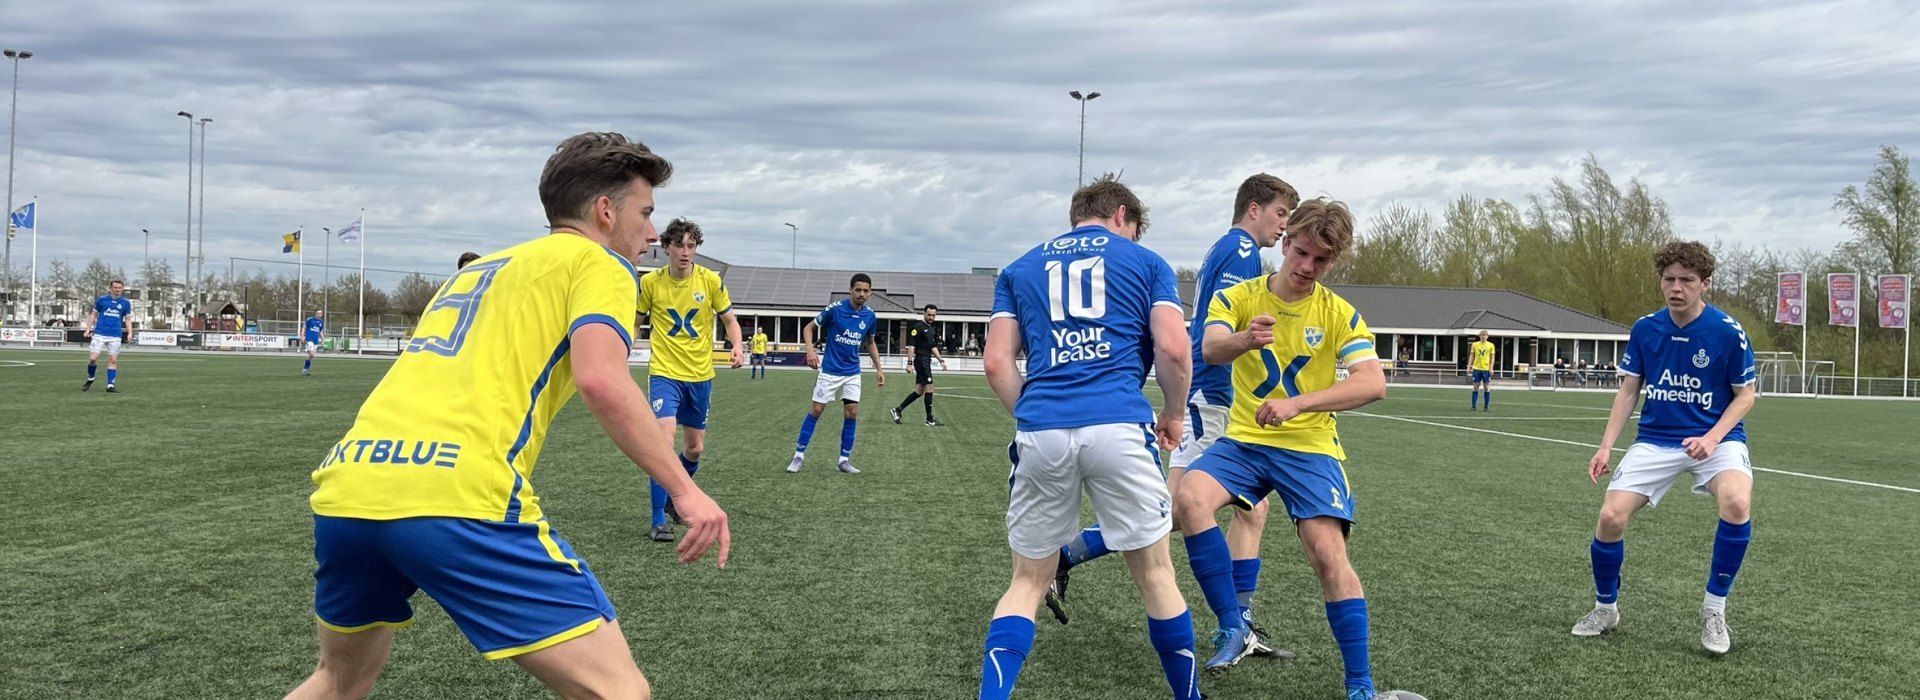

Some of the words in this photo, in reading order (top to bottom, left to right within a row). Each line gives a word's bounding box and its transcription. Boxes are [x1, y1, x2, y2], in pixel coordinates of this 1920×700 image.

[1044, 255, 1106, 321] 10
[405, 256, 513, 357] 9
[232, 335, 278, 343] INTERSPORT
[843, 328, 862, 339] Auto
[1051, 327, 1105, 348] Your
[1050, 342, 1111, 367] lease
[1658, 368, 1702, 389] Auto
[1645, 384, 1713, 411] Smeeing
